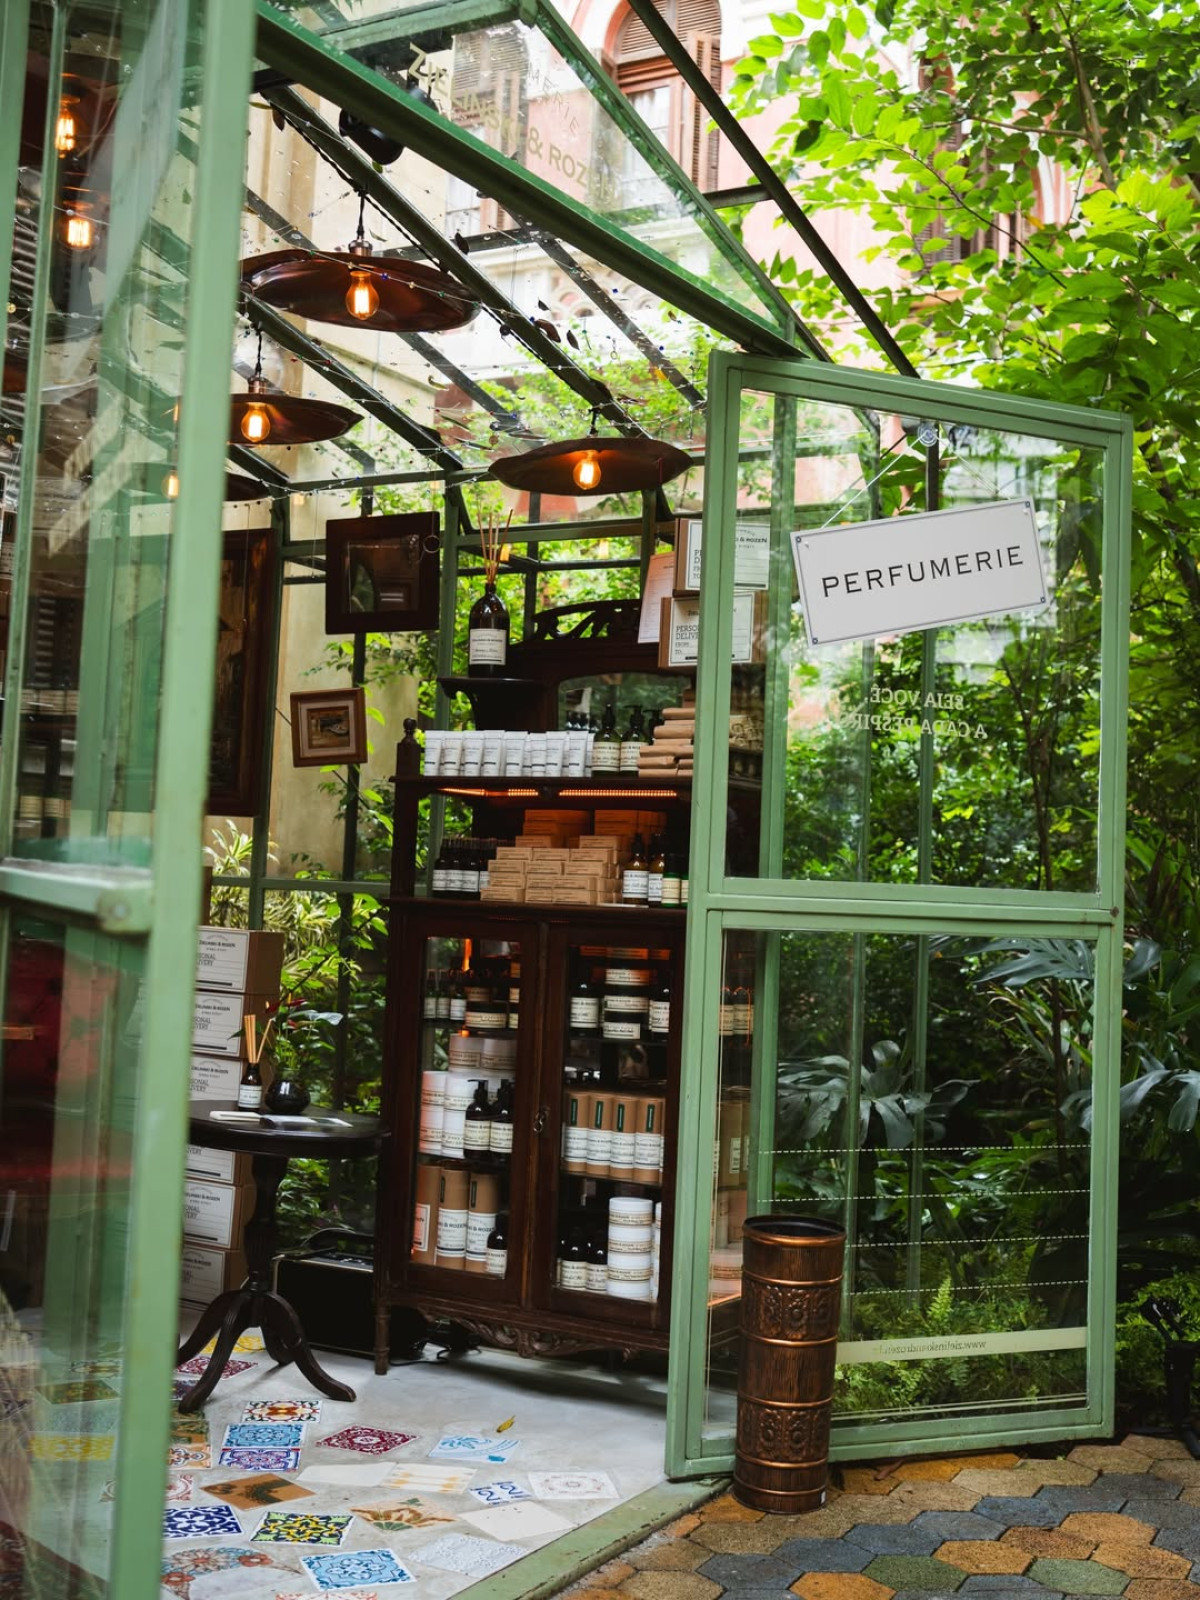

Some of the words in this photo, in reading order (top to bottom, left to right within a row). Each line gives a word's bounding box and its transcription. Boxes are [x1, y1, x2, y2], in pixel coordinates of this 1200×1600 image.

[527, 127, 543, 160] &
[822, 545, 1024, 597] PERFUMERIE
[675, 625, 700, 633] PERSO
